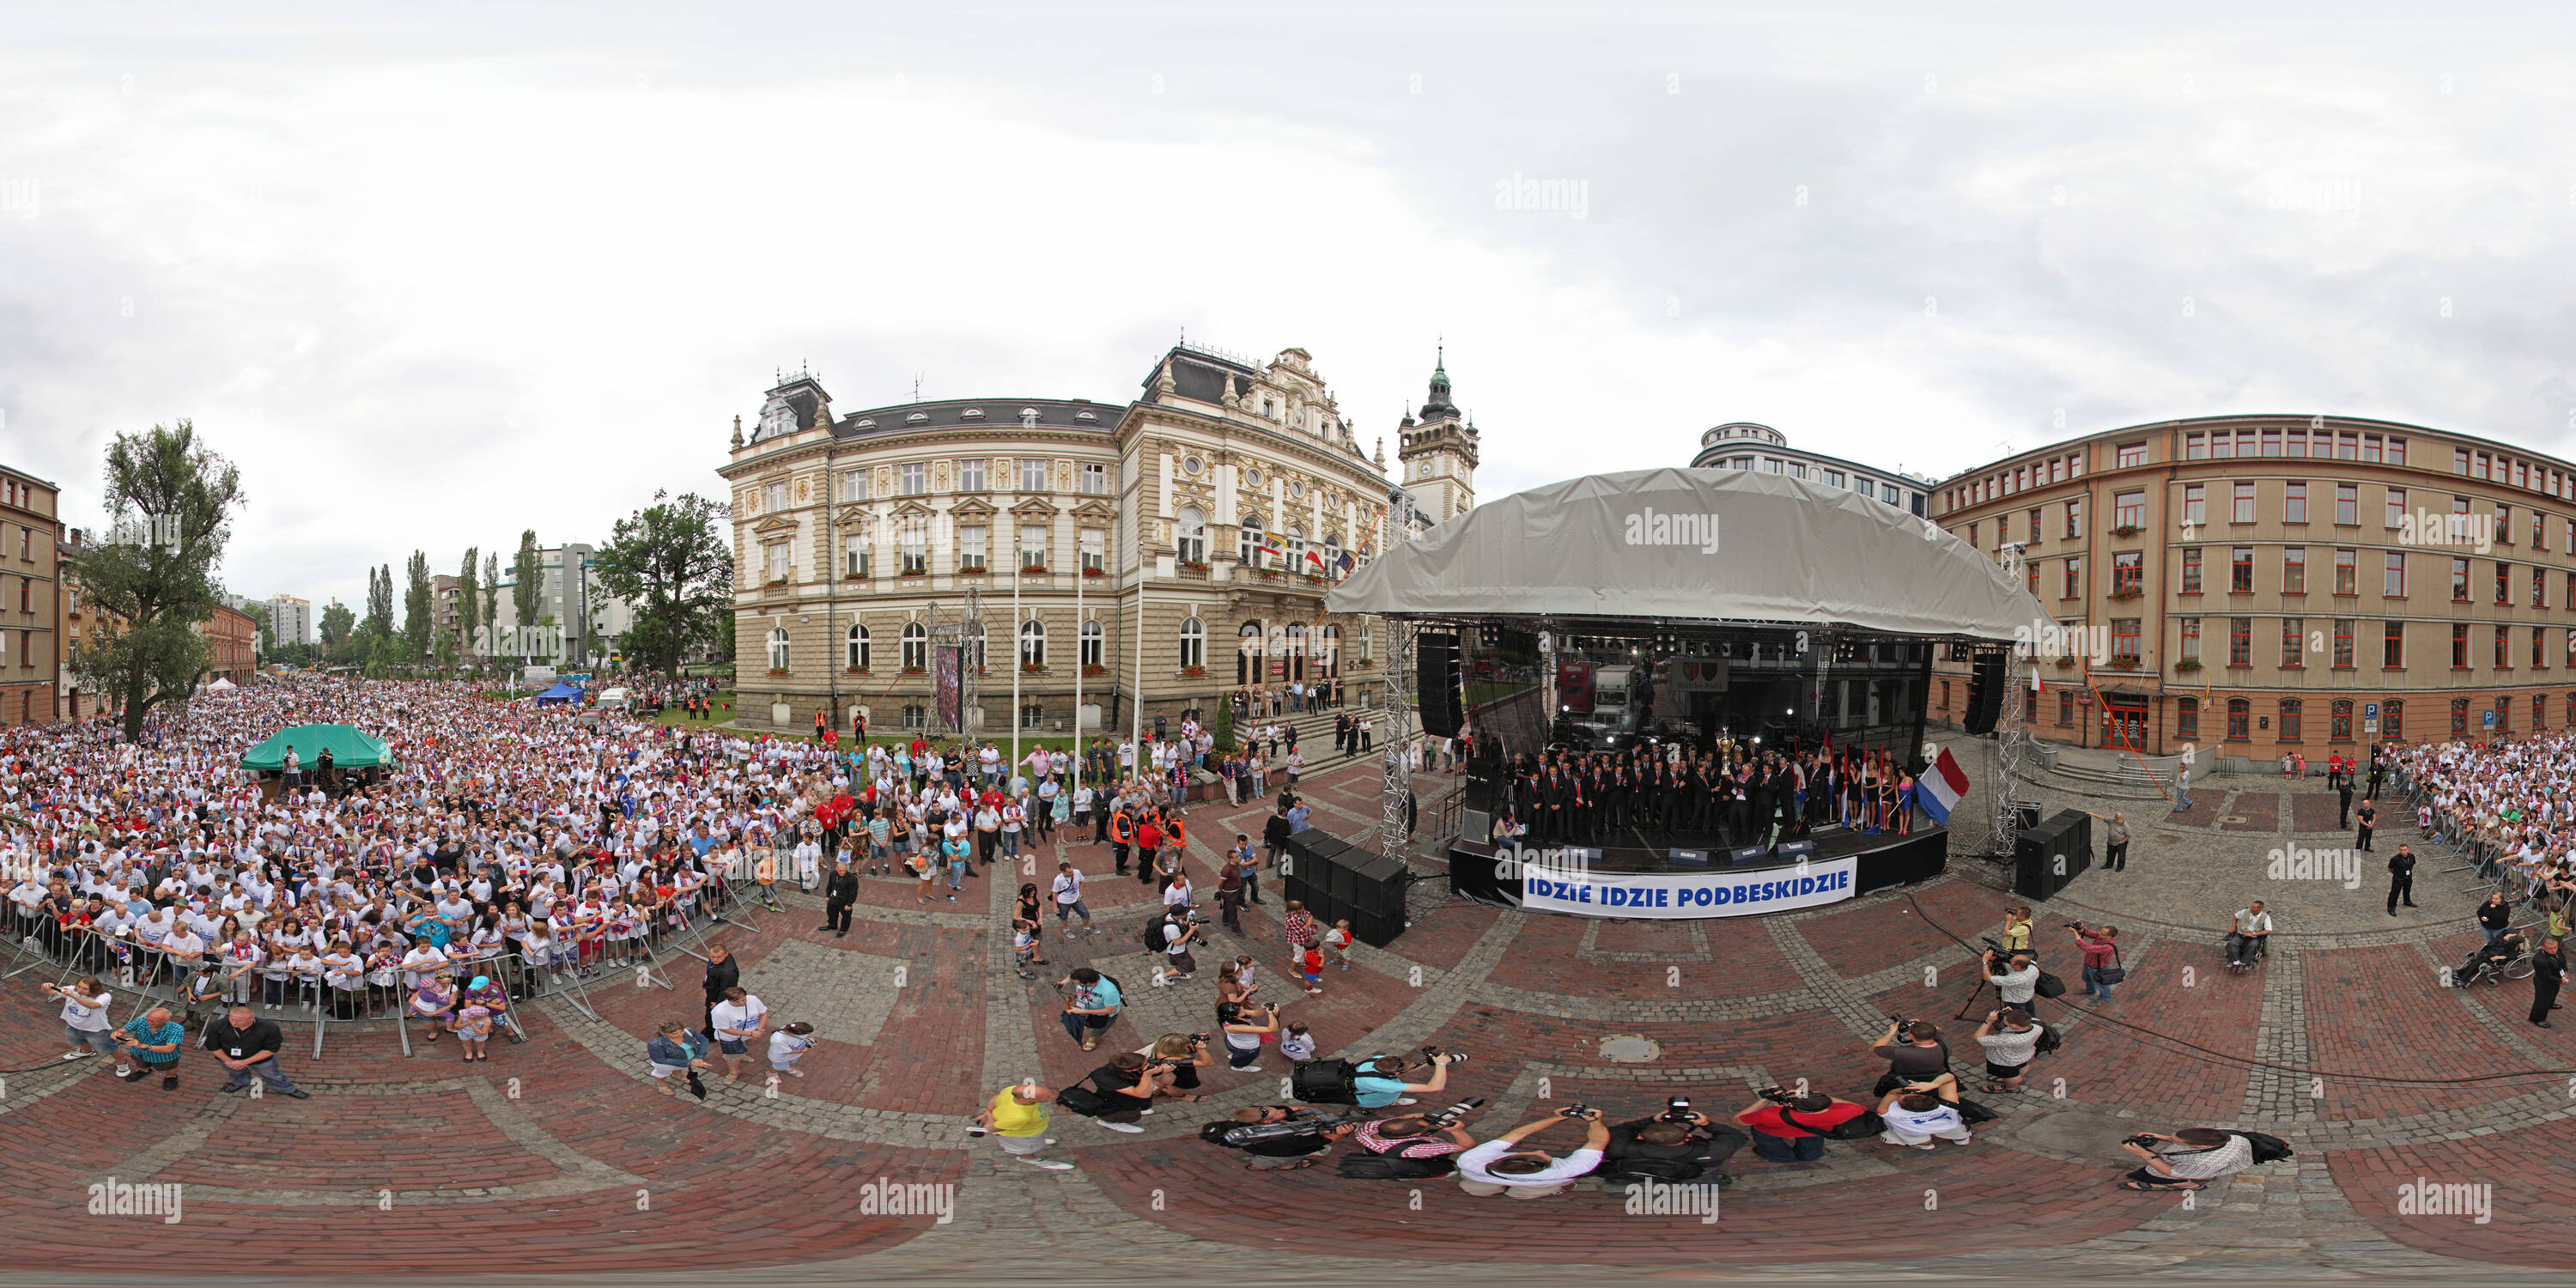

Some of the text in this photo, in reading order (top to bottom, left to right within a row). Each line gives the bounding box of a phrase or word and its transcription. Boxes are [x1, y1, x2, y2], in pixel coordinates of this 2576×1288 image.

[2367, 705, 2375, 715] P
[2485, 712, 2493, 721] P
[1528, 870, 1849, 908] IDZIE IDZIE PODBESKIDZIE
